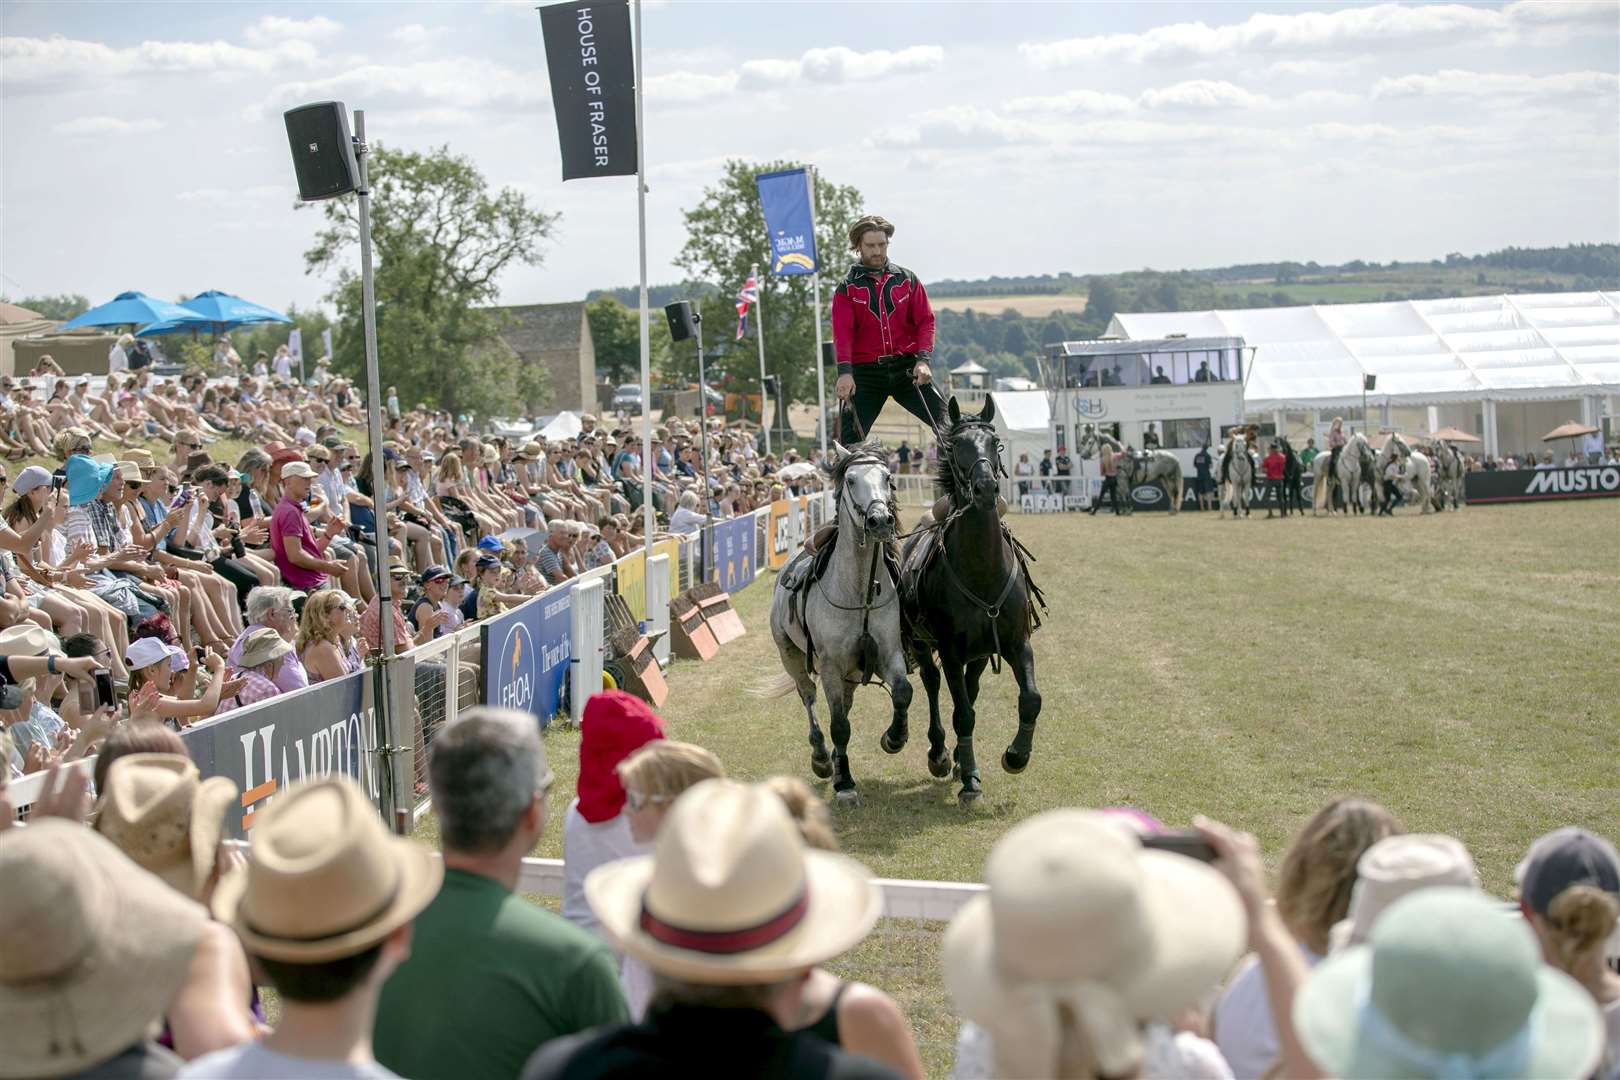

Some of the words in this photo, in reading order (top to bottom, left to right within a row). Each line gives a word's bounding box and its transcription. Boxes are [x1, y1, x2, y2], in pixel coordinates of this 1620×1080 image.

[577, 8, 597, 66] HOUSE
[584, 71, 601, 95] OF
[588, 101, 609, 167] FRASER
[1525, 467, 1620, 493] MUSTO
